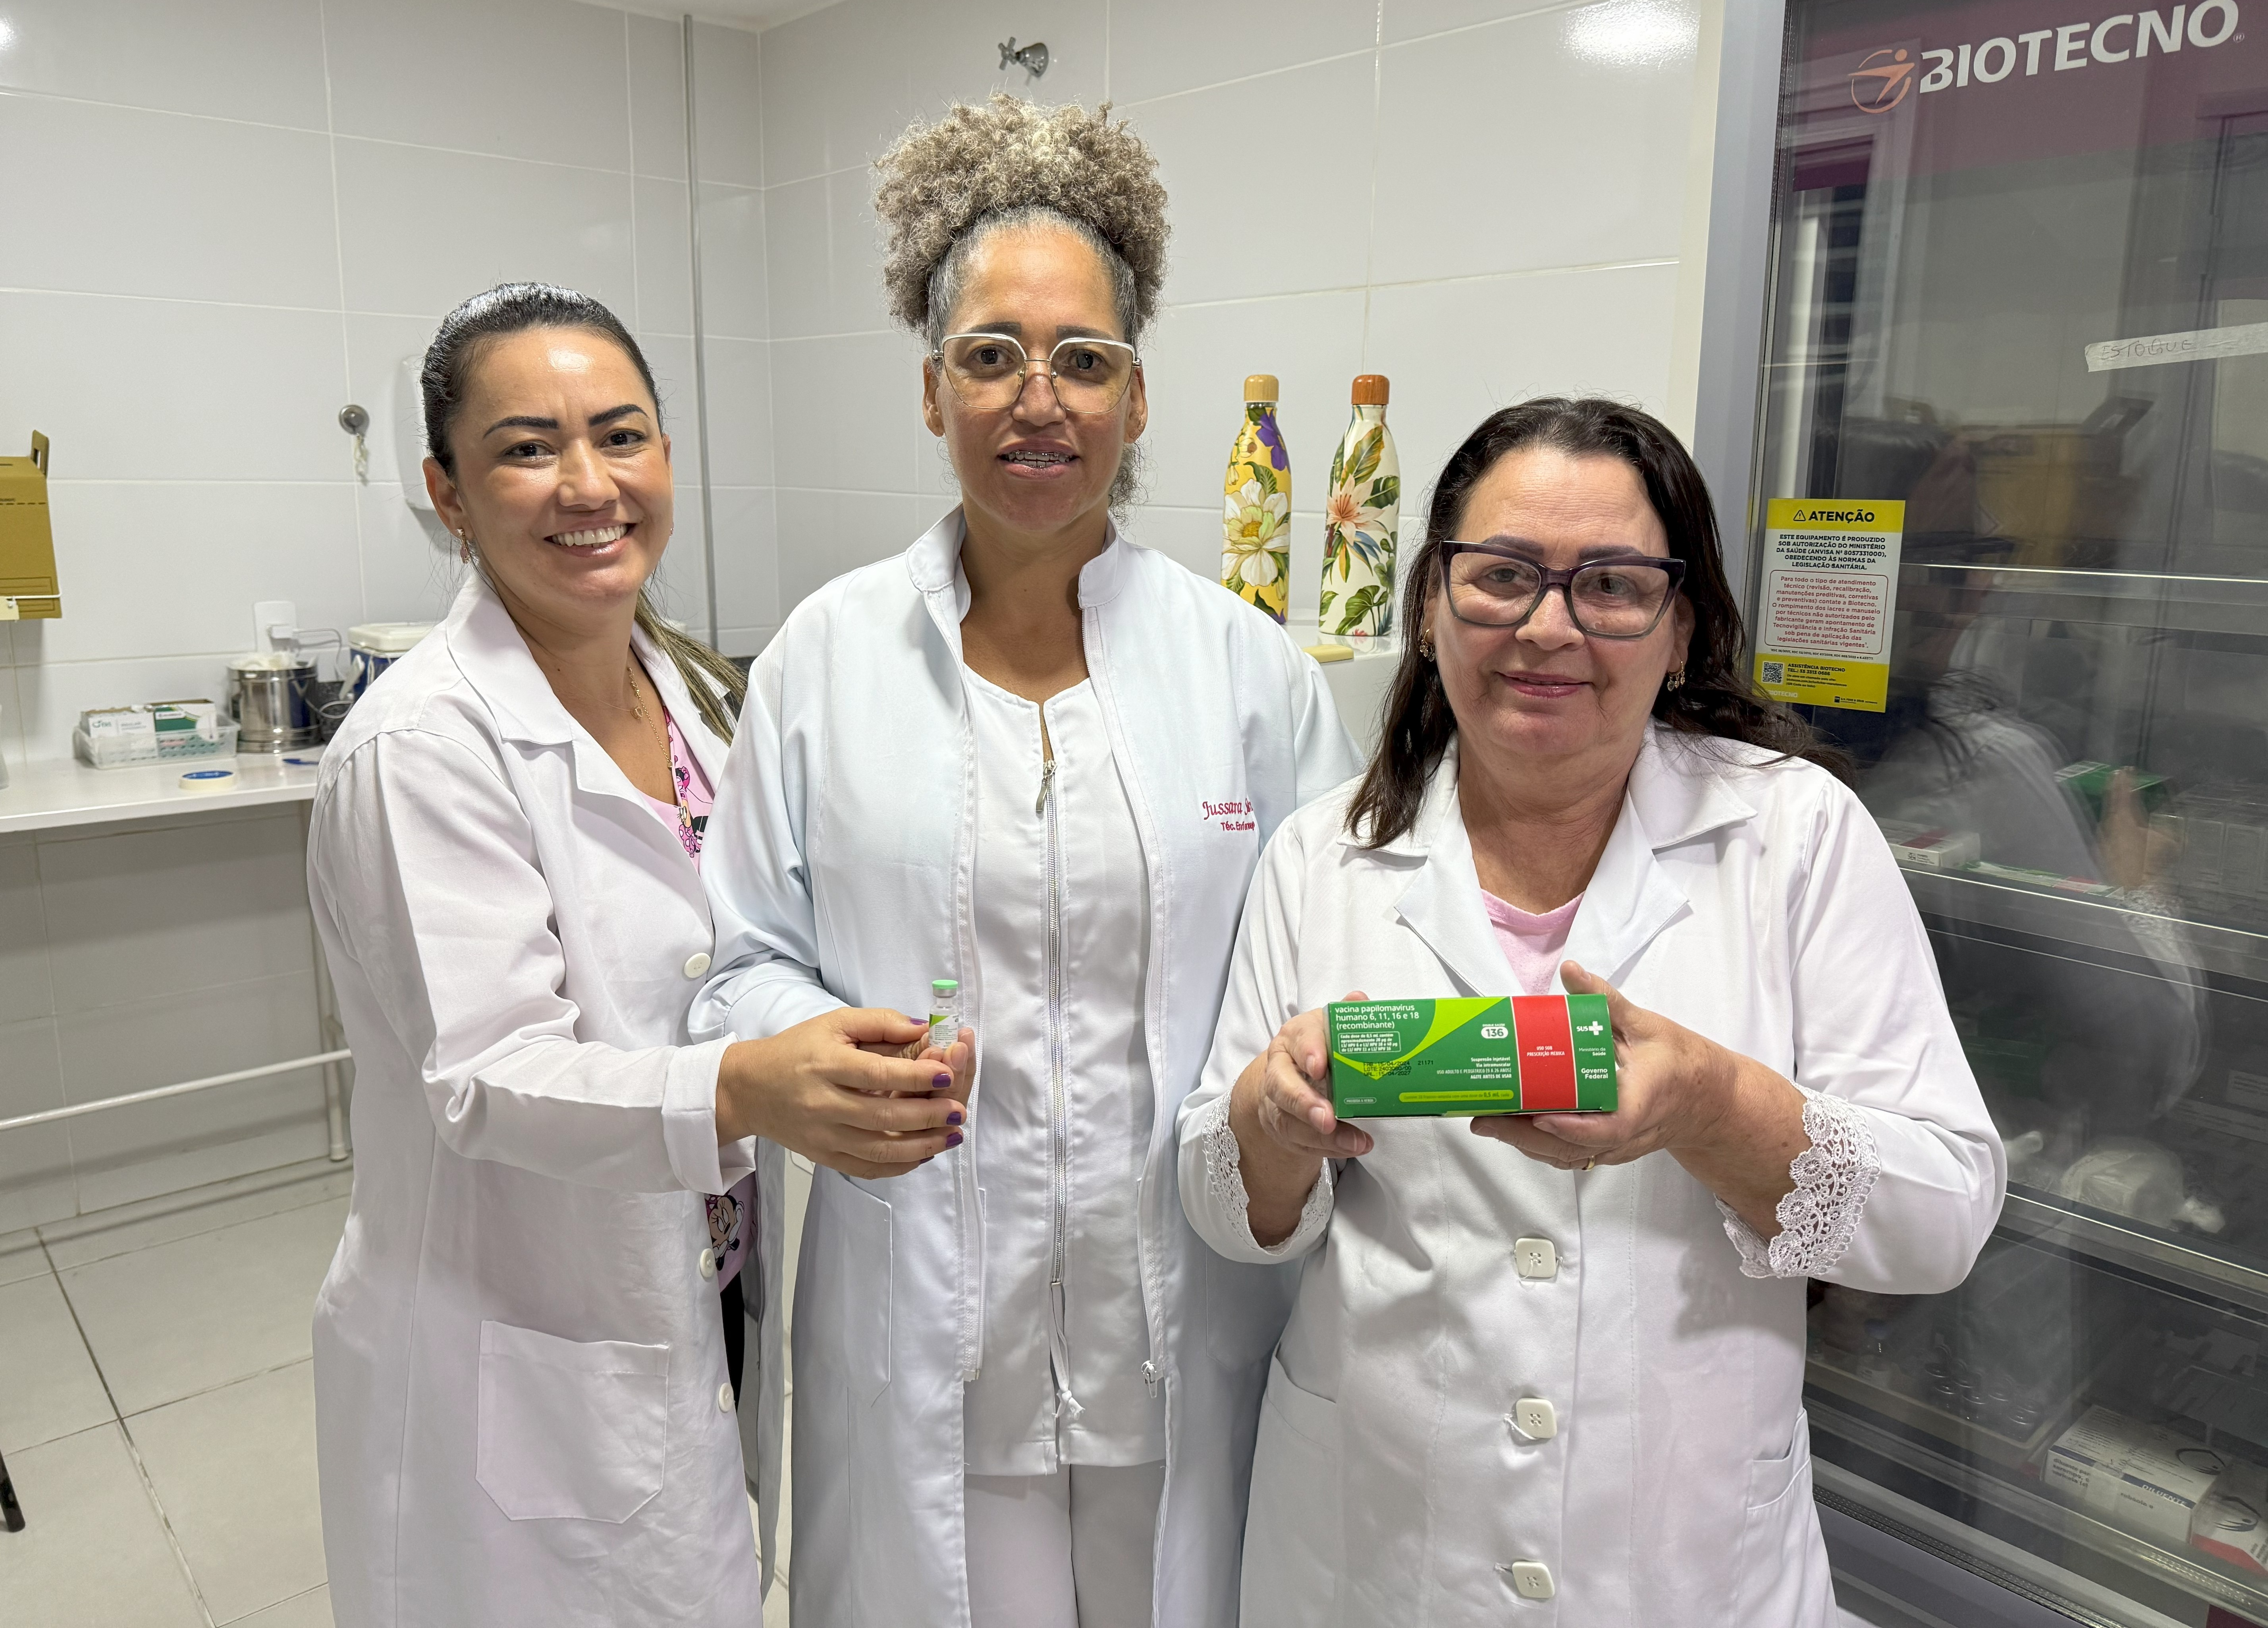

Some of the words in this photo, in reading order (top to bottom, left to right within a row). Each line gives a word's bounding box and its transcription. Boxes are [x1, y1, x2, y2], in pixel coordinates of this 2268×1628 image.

[1919, 0, 2239, 94] BIOTECNO
[1808, 509, 1875, 523] ATENÇÃO
[1202, 801, 1242, 820] Jussara
[1336, 1021, 1394, 1031] (recombinante)
[1486, 1028, 1504, 1037] 136
